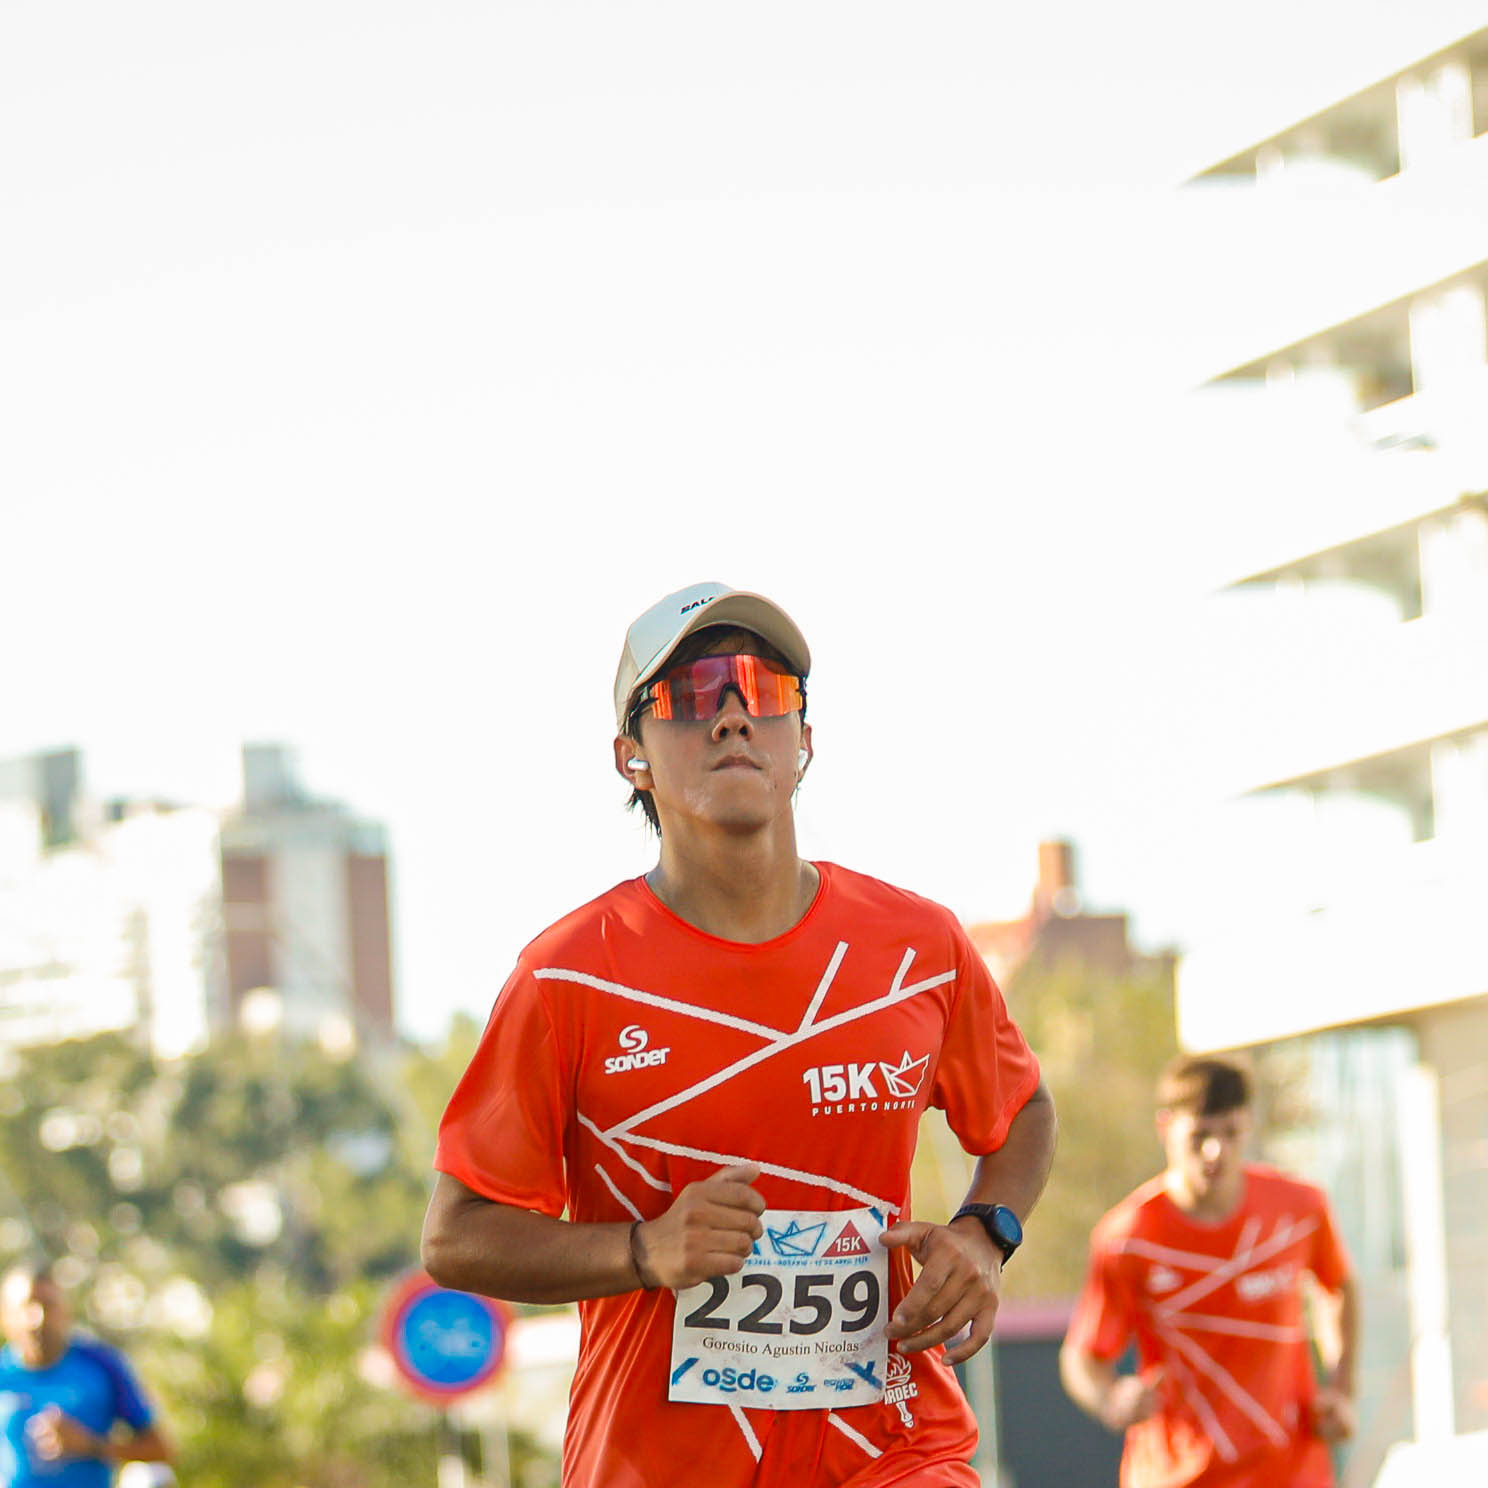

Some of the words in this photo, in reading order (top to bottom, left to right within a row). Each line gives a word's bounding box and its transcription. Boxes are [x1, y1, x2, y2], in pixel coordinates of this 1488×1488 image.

[803, 1062, 879, 1104] 15K
[812, 1102, 878, 1117] PUERTO
[834, 1235, 862, 1254] 15K
[684, 1270, 880, 1336] 2259
[702, 1336, 758, 1355] Gorosito
[762, 1342, 811, 1359] Agustin
[814, 1340, 860, 1355] Nicolas
[702, 1367, 776, 1393] osde
